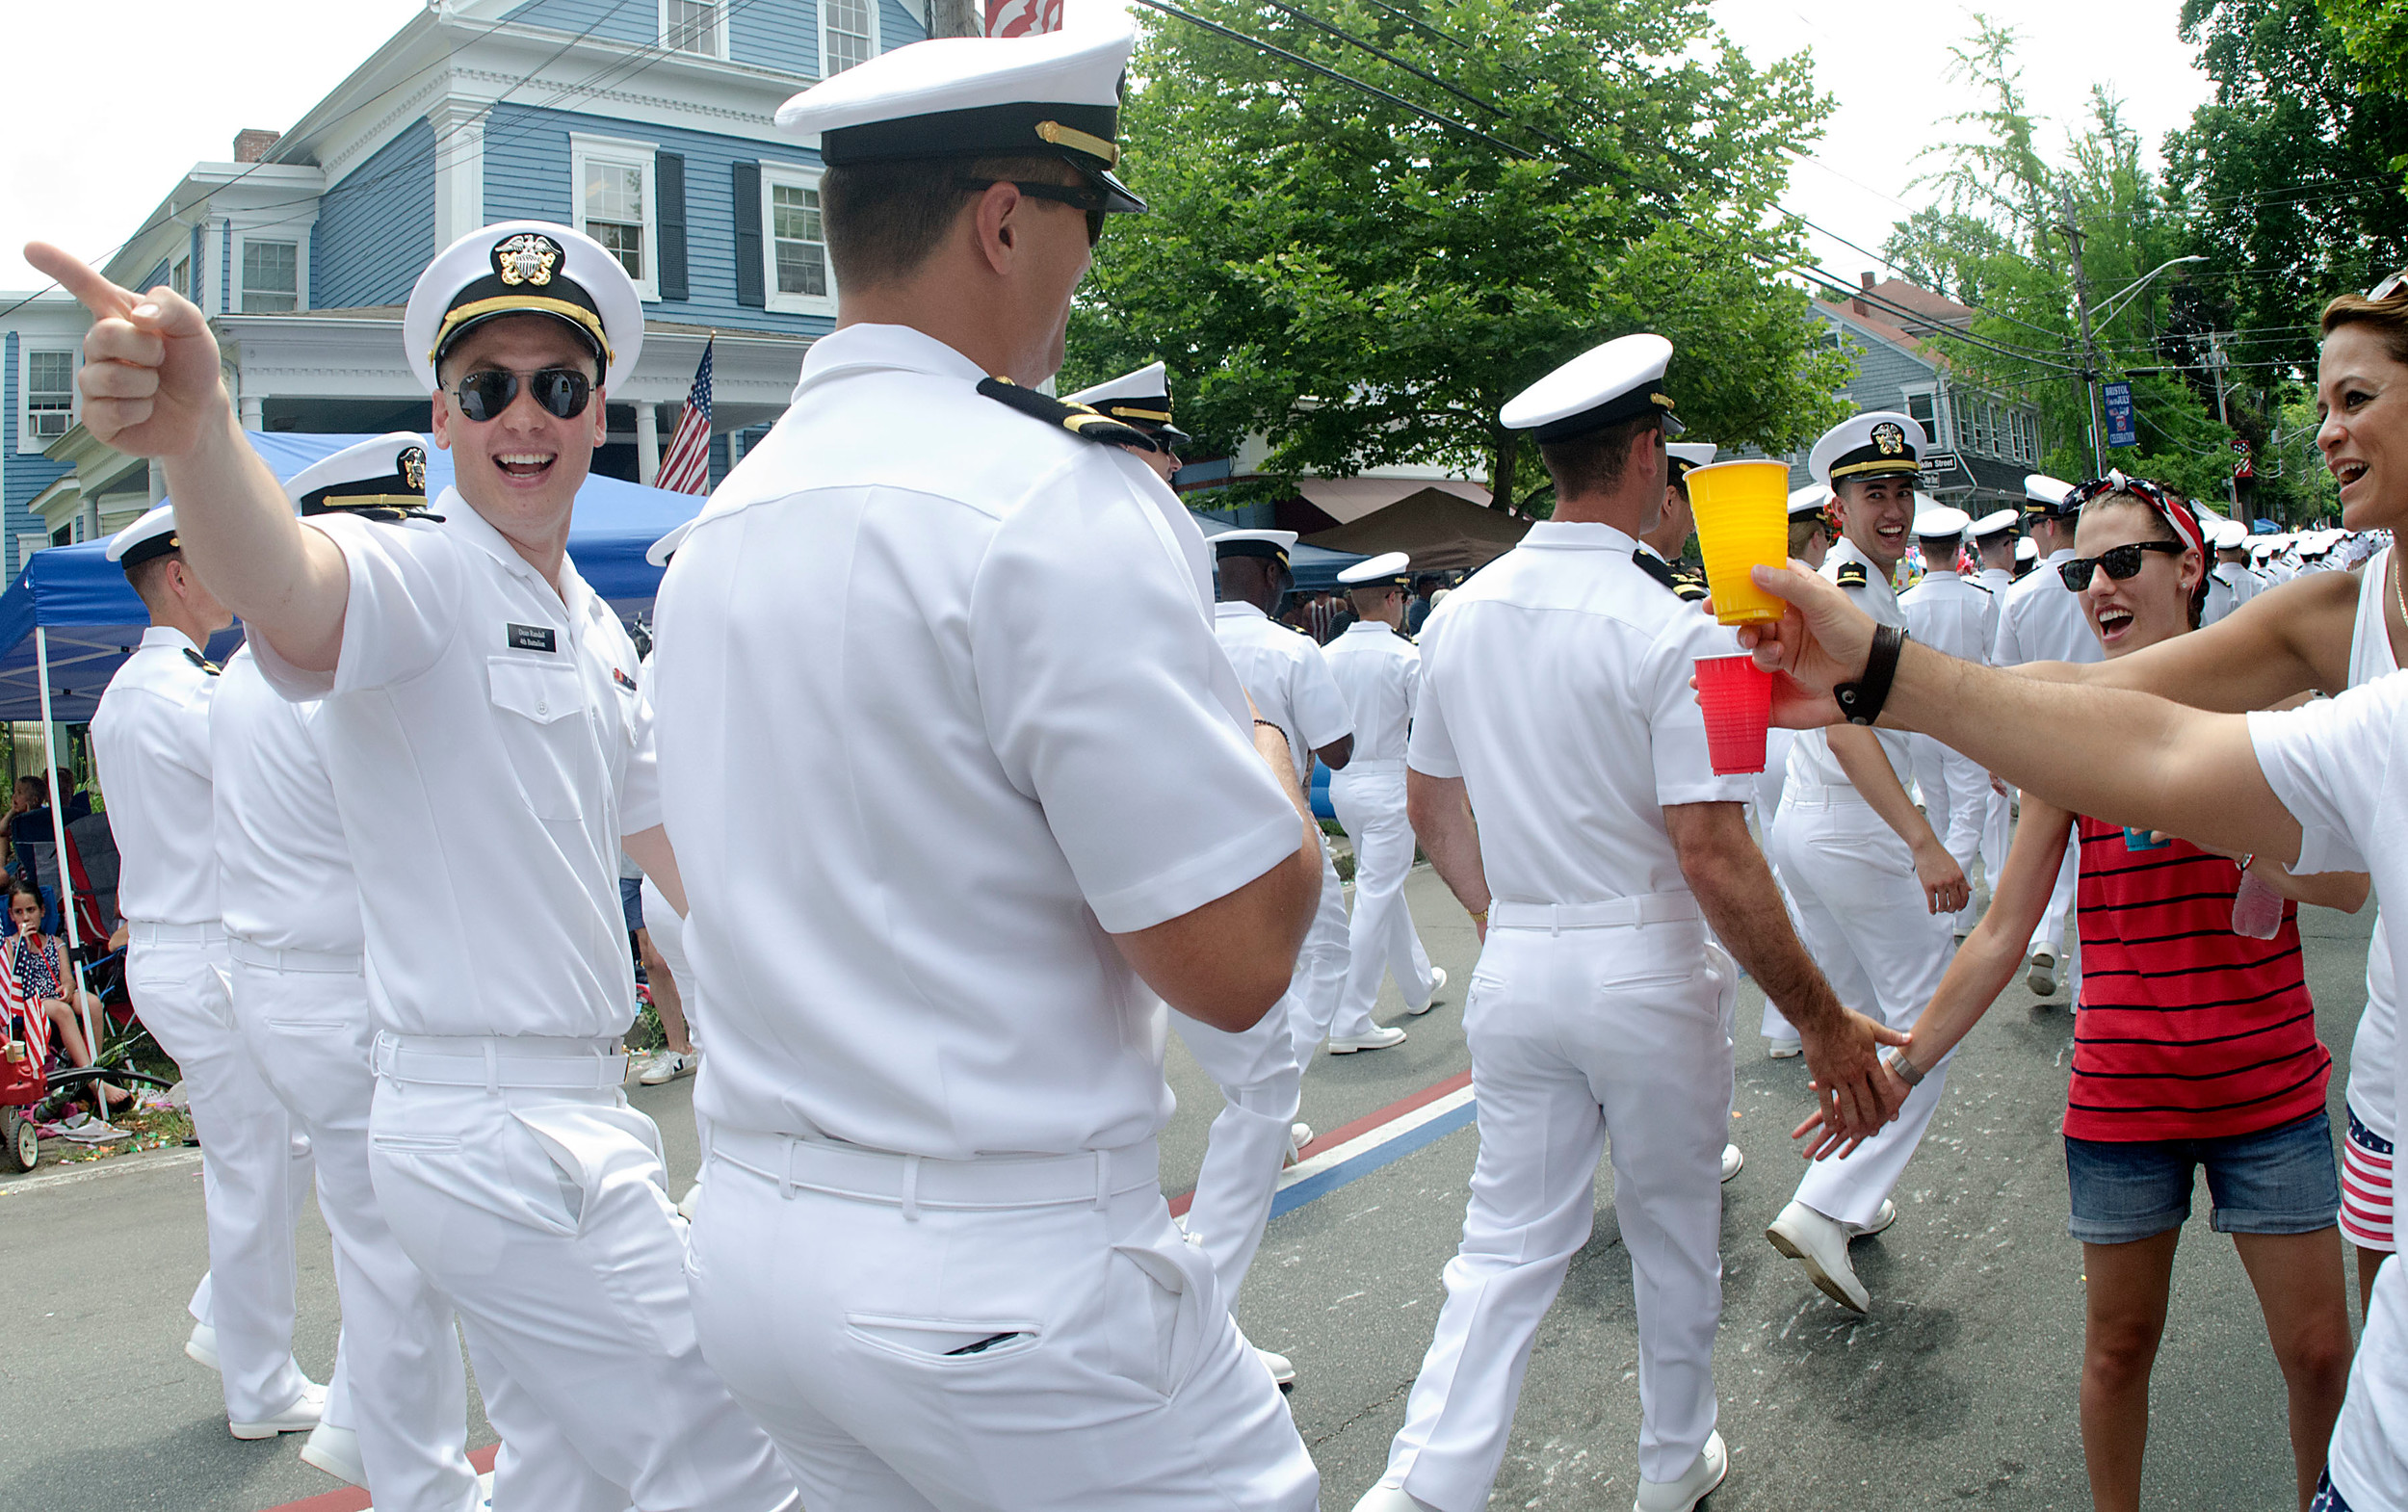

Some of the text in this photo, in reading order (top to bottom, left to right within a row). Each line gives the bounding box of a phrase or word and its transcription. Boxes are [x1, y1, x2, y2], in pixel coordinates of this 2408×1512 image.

[2105, 385, 2128, 396] BRISTOL
[2110, 432, 2135, 443] CELEBRATION
[1935, 459, 1953, 467] Street
[527, 639, 545, 647] Battalion
